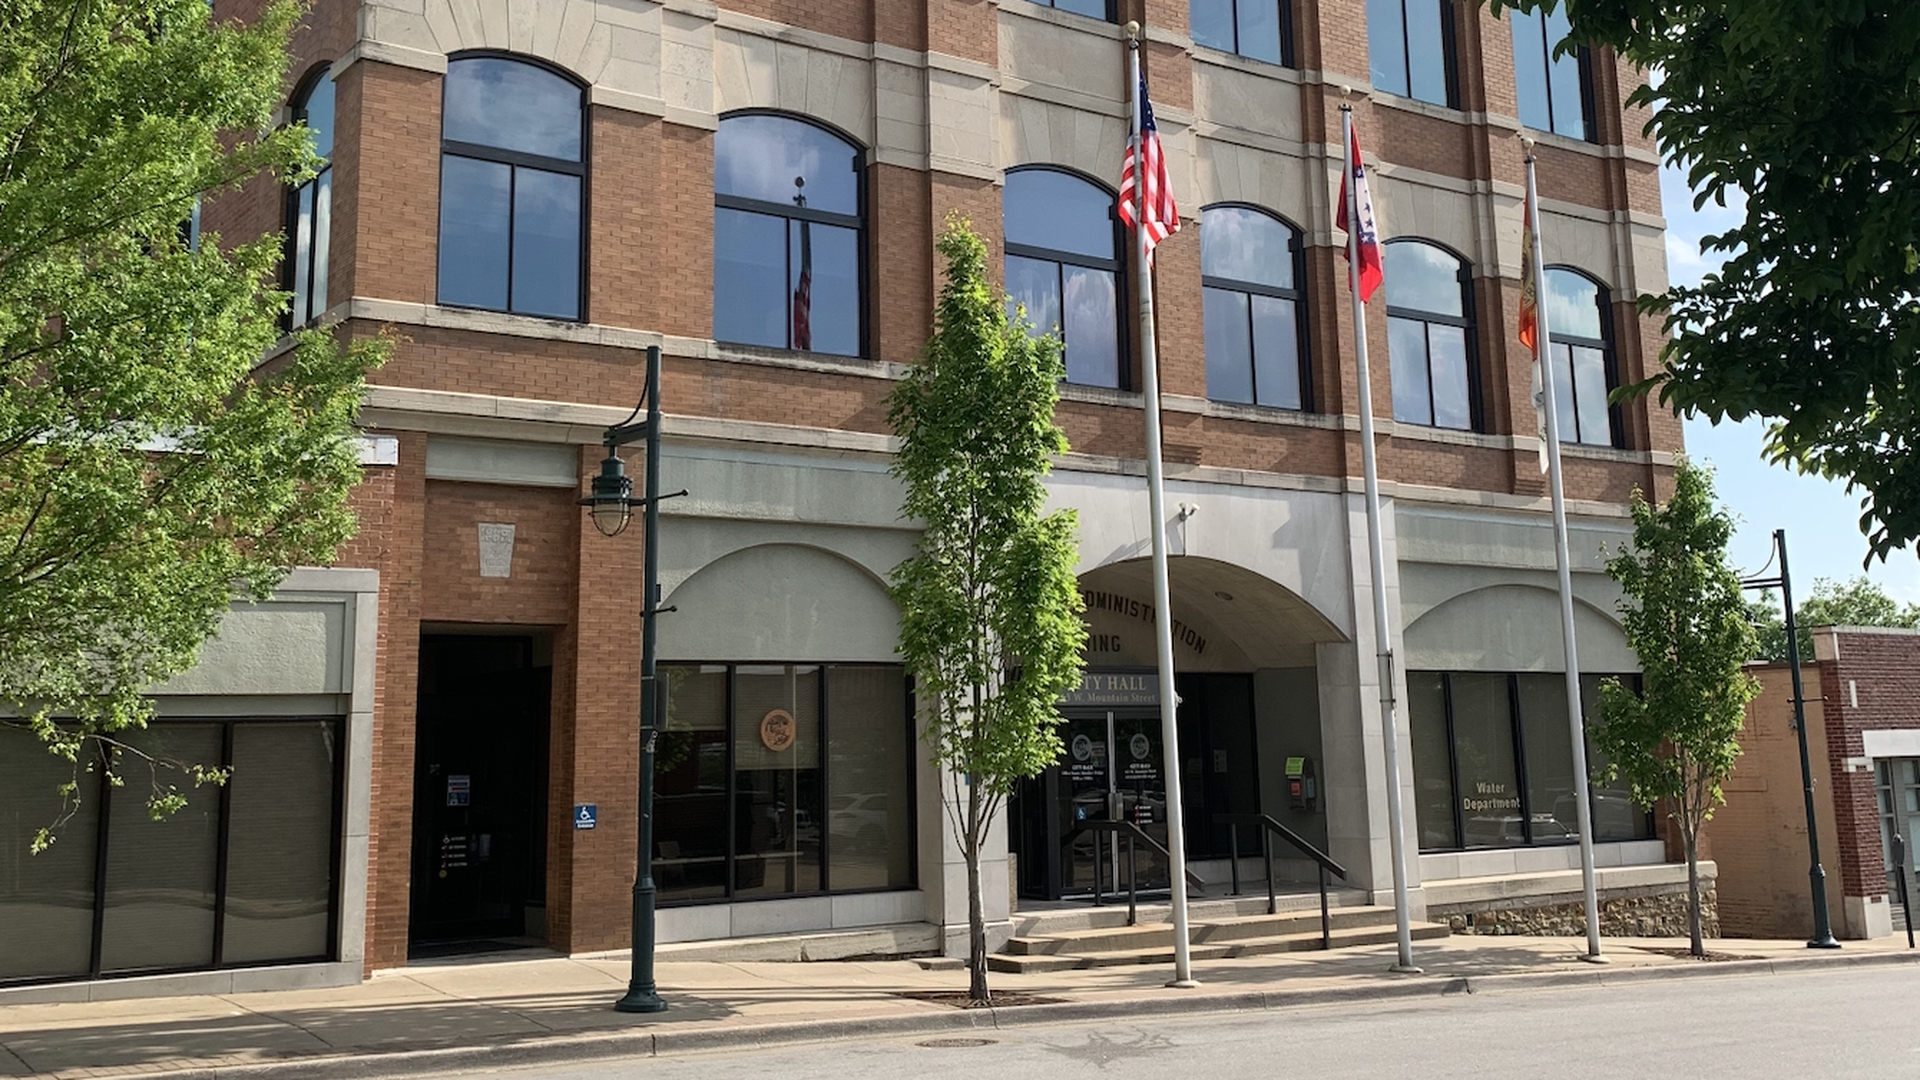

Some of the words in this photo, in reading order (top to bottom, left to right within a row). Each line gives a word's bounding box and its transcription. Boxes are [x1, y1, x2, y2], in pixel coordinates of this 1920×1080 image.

[1085, 589, 1206, 655] DMINISTTION
[1107, 676, 1147, 691] HALL
[1073, 691, 1085, 702] W.
[1087, 692, 1129, 703] Mountain
[1131, 692, 1156, 703] Street
[1476, 782, 1505, 794] Water
[1463, 797, 1520, 812] Department
